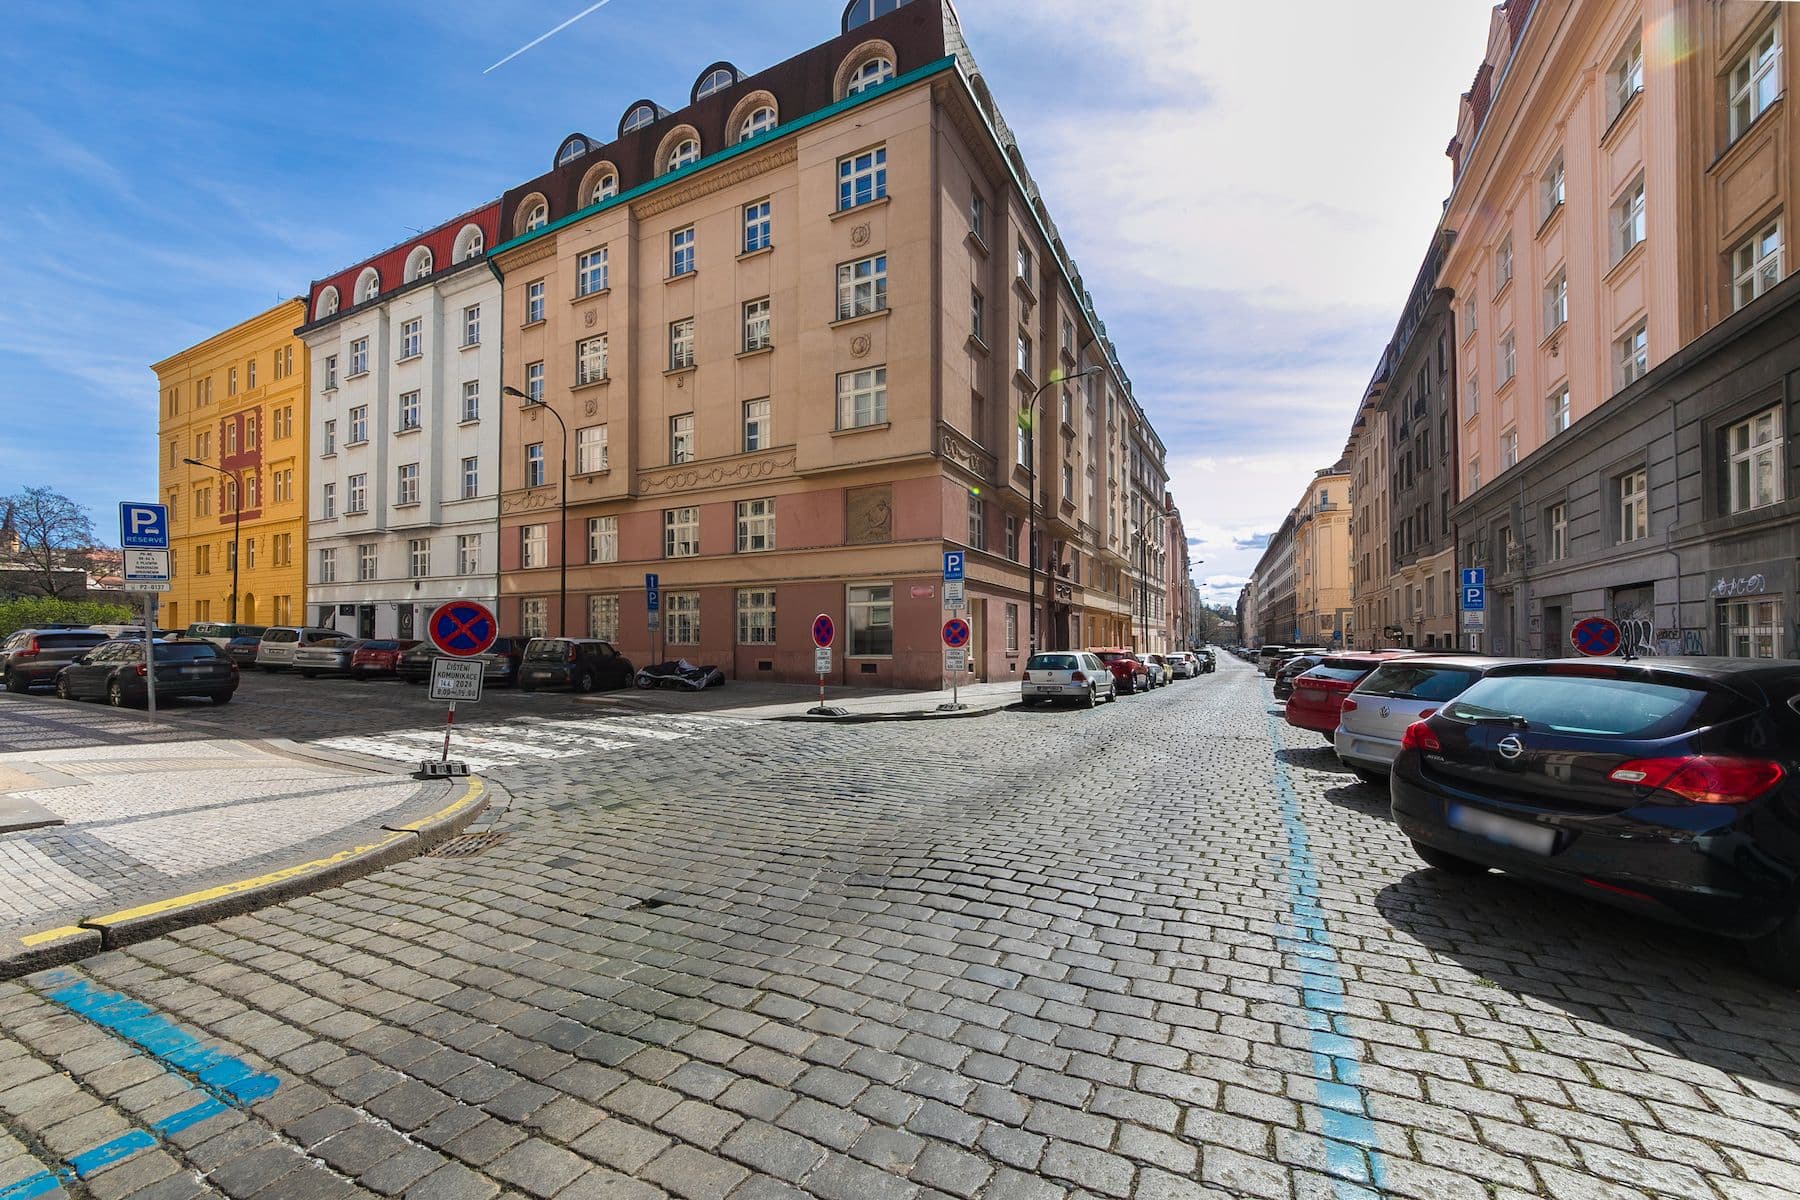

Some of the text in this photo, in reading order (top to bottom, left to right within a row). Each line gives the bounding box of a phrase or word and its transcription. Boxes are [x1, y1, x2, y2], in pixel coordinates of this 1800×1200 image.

[131, 508, 157, 534] P
[1467, 588, 1480, 603] P
[446, 663, 472, 672] ČIŠTĚNÍ
[437, 672, 478, 680] KOMUNIKACE
